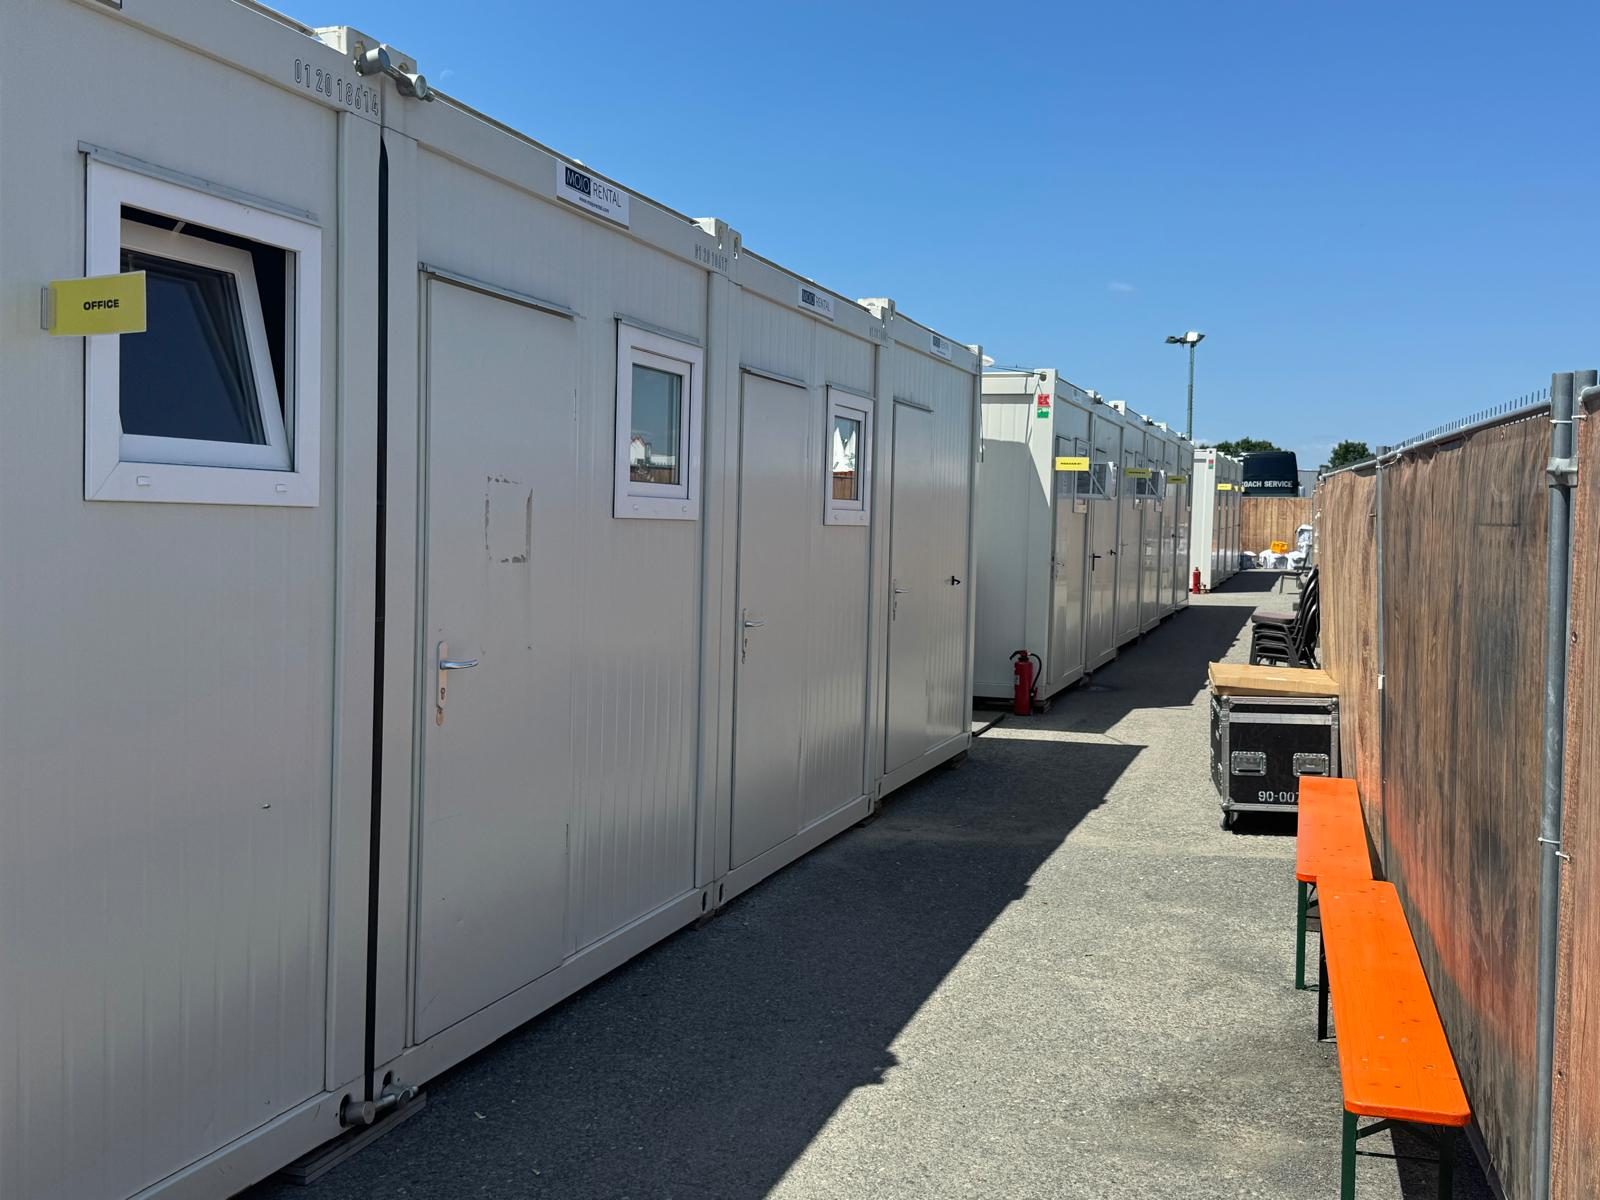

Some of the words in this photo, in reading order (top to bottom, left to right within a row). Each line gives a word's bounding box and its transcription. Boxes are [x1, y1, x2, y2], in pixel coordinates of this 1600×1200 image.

[593, 182, 622, 208] RENTAL
[83, 299, 120, 311] OFFICE
[1241, 480, 1262, 488] OACH
[1264, 480, 1293, 488] SERVICE
